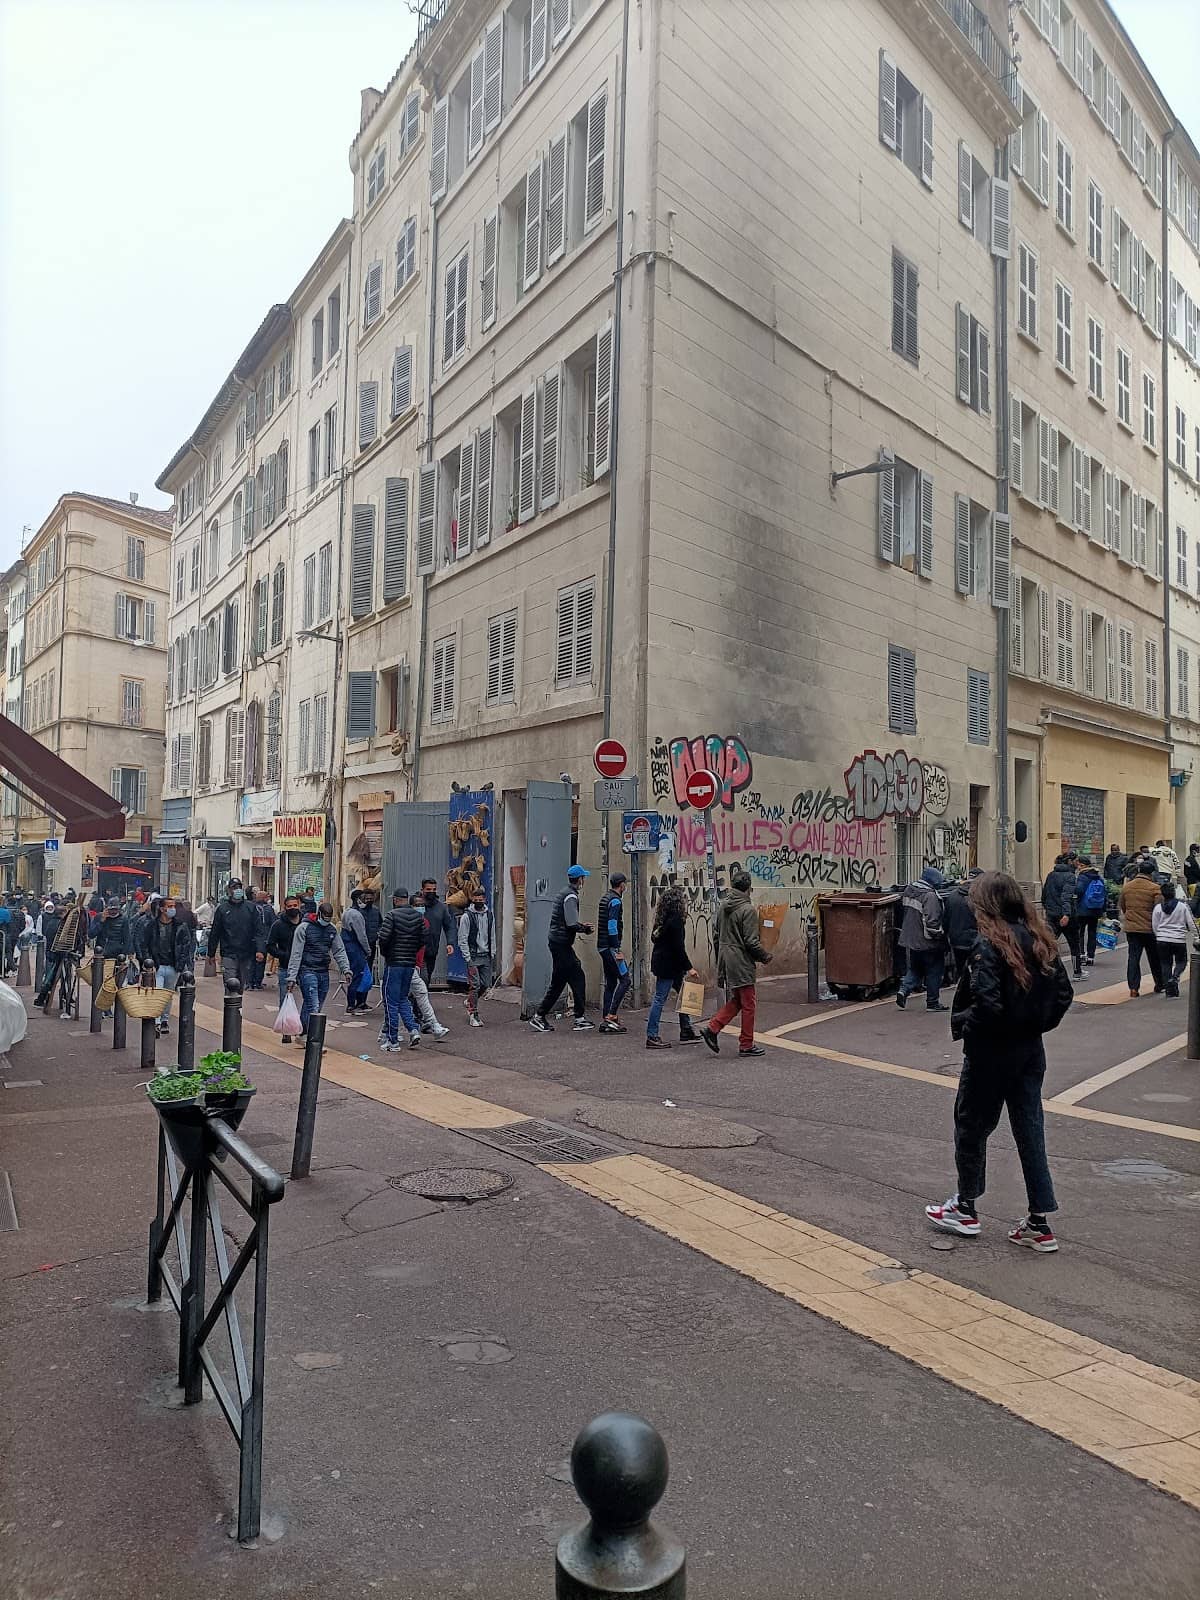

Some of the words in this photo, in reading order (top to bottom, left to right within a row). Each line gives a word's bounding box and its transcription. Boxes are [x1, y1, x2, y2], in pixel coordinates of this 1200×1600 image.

[604, 782, 625, 791] SAUF
[275, 817, 297, 838] TOUBA
[298, 815, 323, 837] BAZAR
